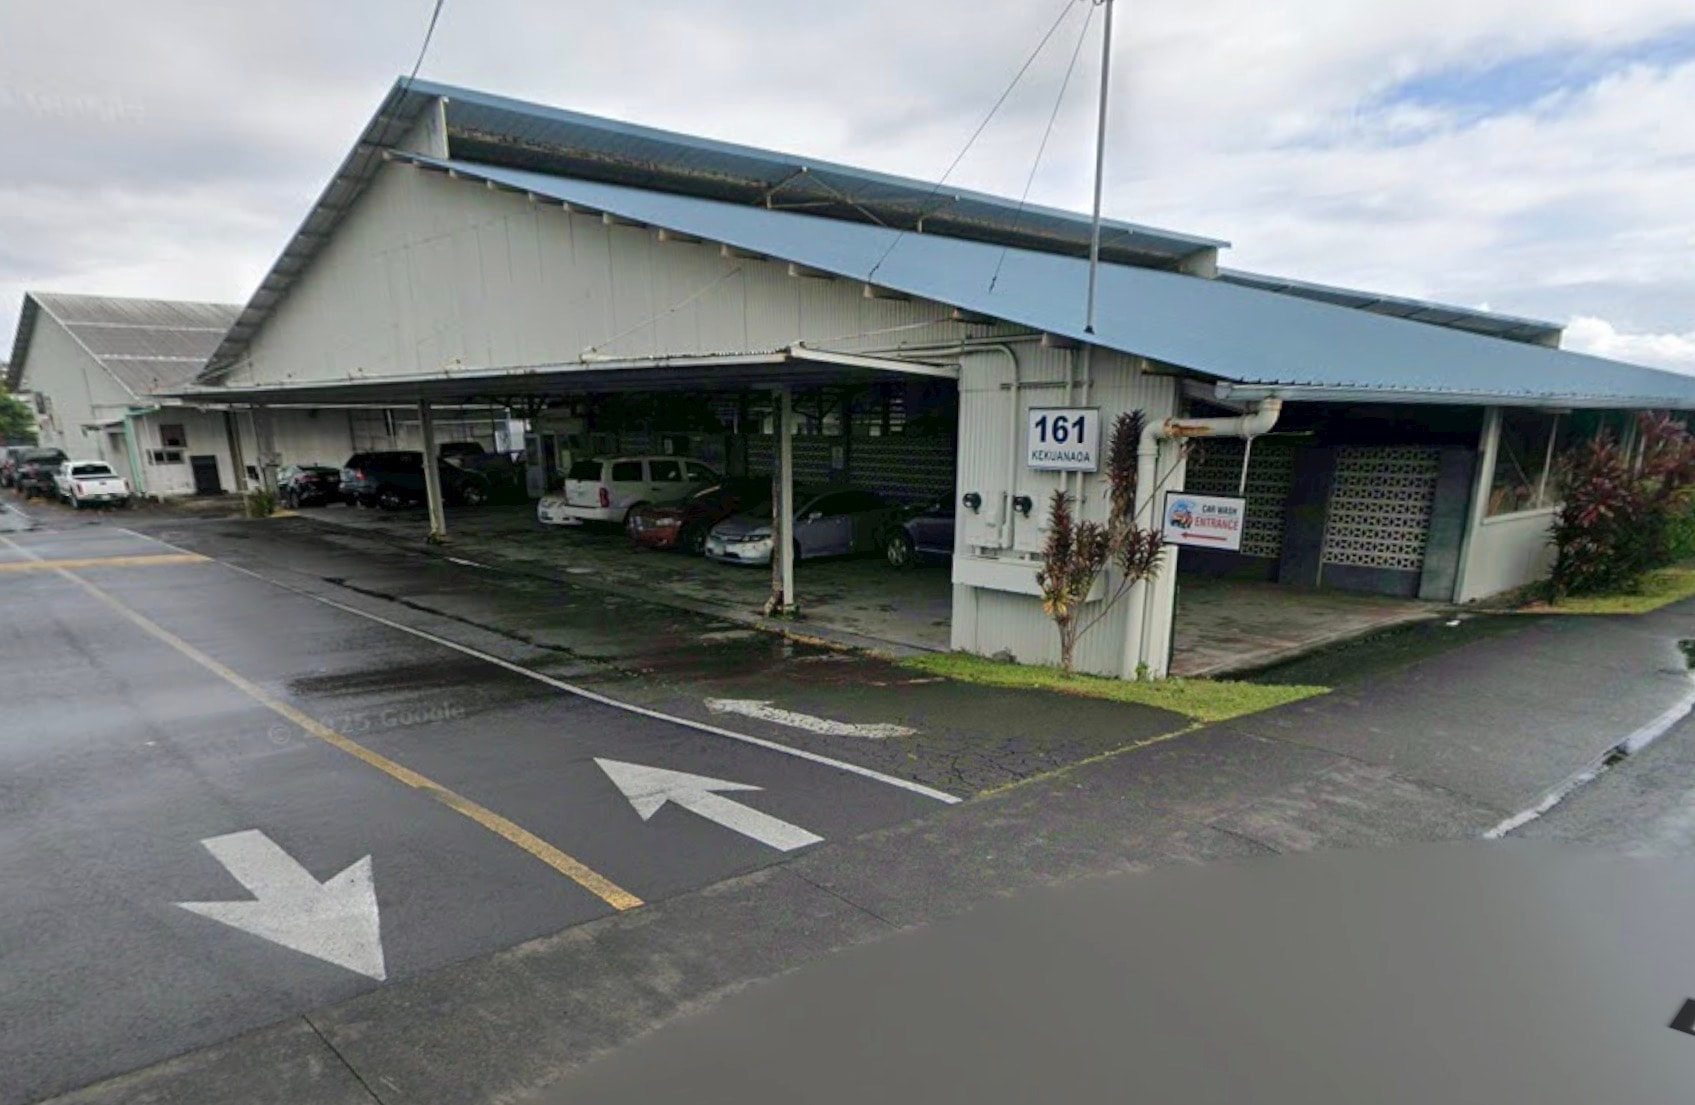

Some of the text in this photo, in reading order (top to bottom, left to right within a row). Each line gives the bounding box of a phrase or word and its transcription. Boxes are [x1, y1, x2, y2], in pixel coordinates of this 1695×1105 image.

[1035, 415, 1085, 444] 161
[1031, 449, 1090, 462] KEKUANAOA
[1202, 504, 1238, 515] CAR WASH
[1194, 516, 1240, 531] ENTRANCE
